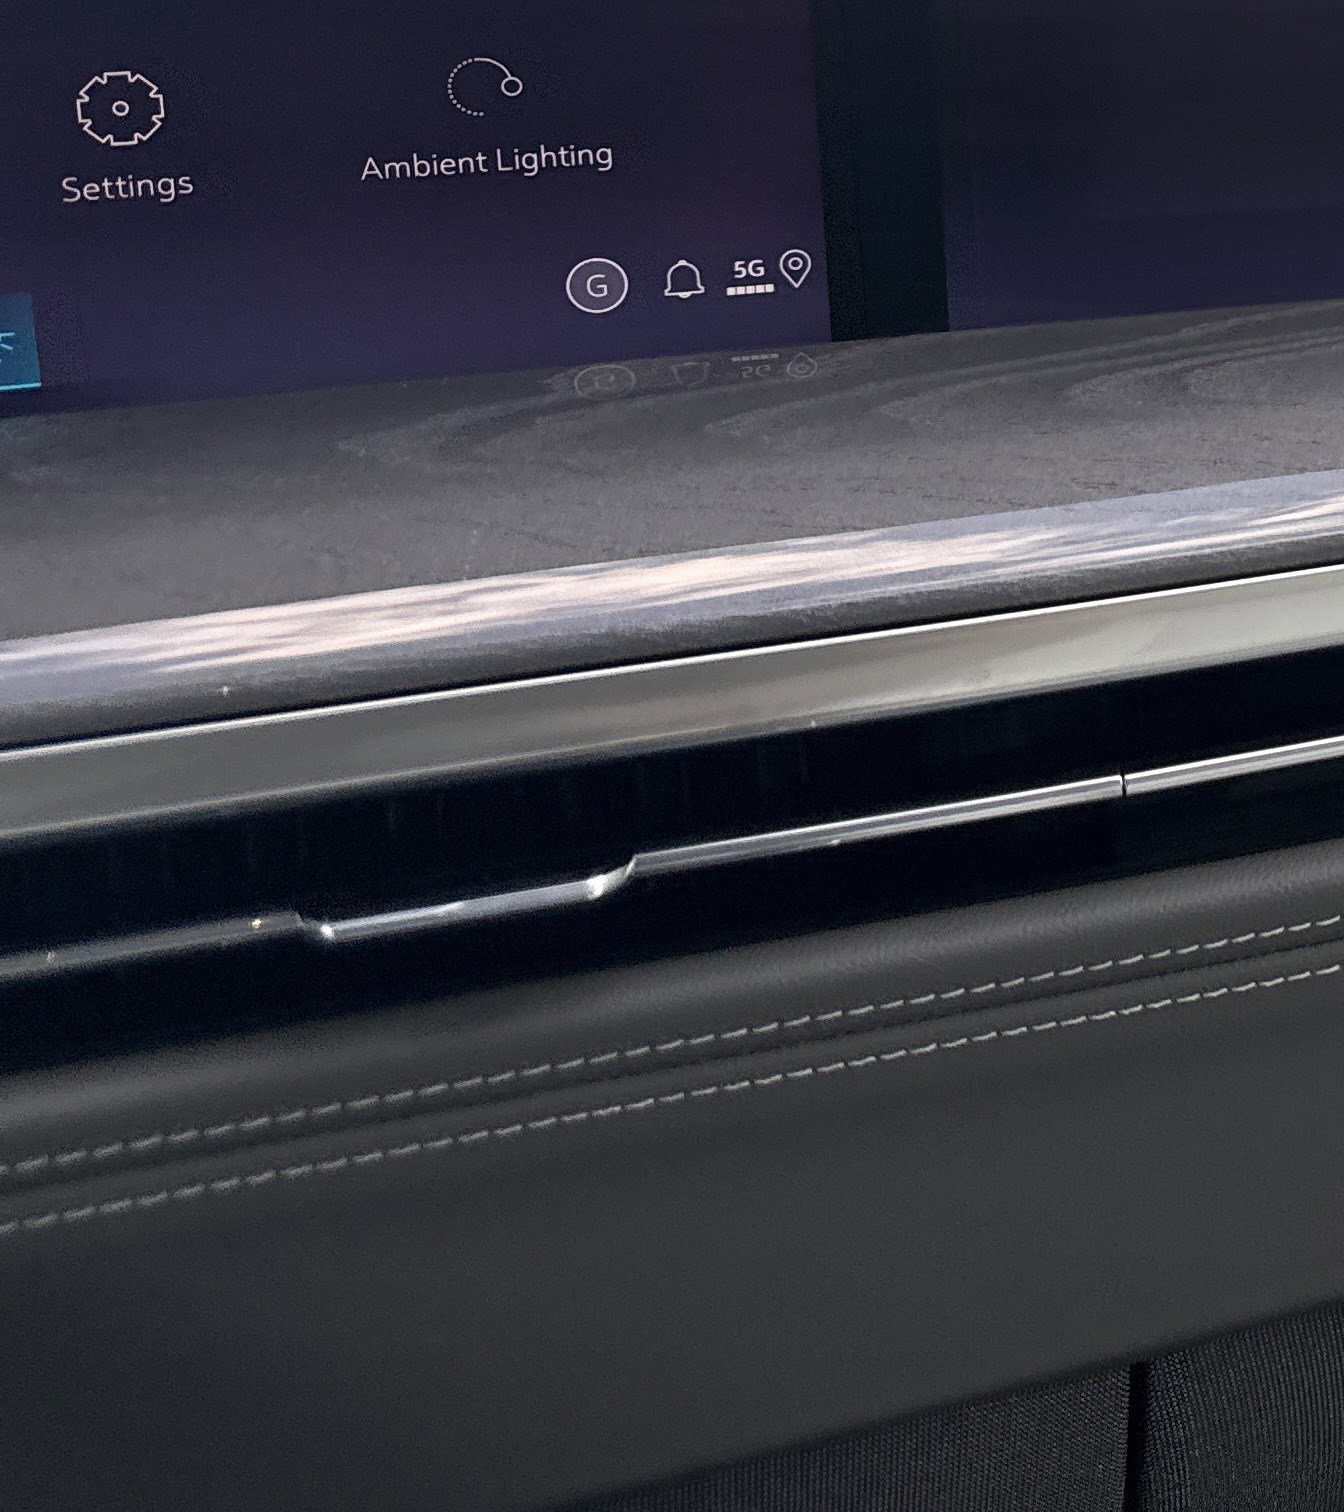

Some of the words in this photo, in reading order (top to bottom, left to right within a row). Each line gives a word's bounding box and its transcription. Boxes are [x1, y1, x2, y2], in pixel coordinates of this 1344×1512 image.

[361, 152, 488, 181] Ambient
[496, 144, 613, 176] Lighting
[62, 174, 193, 203] Settings
[734, 259, 765, 279] 5G
[586, 274, 608, 297] G
